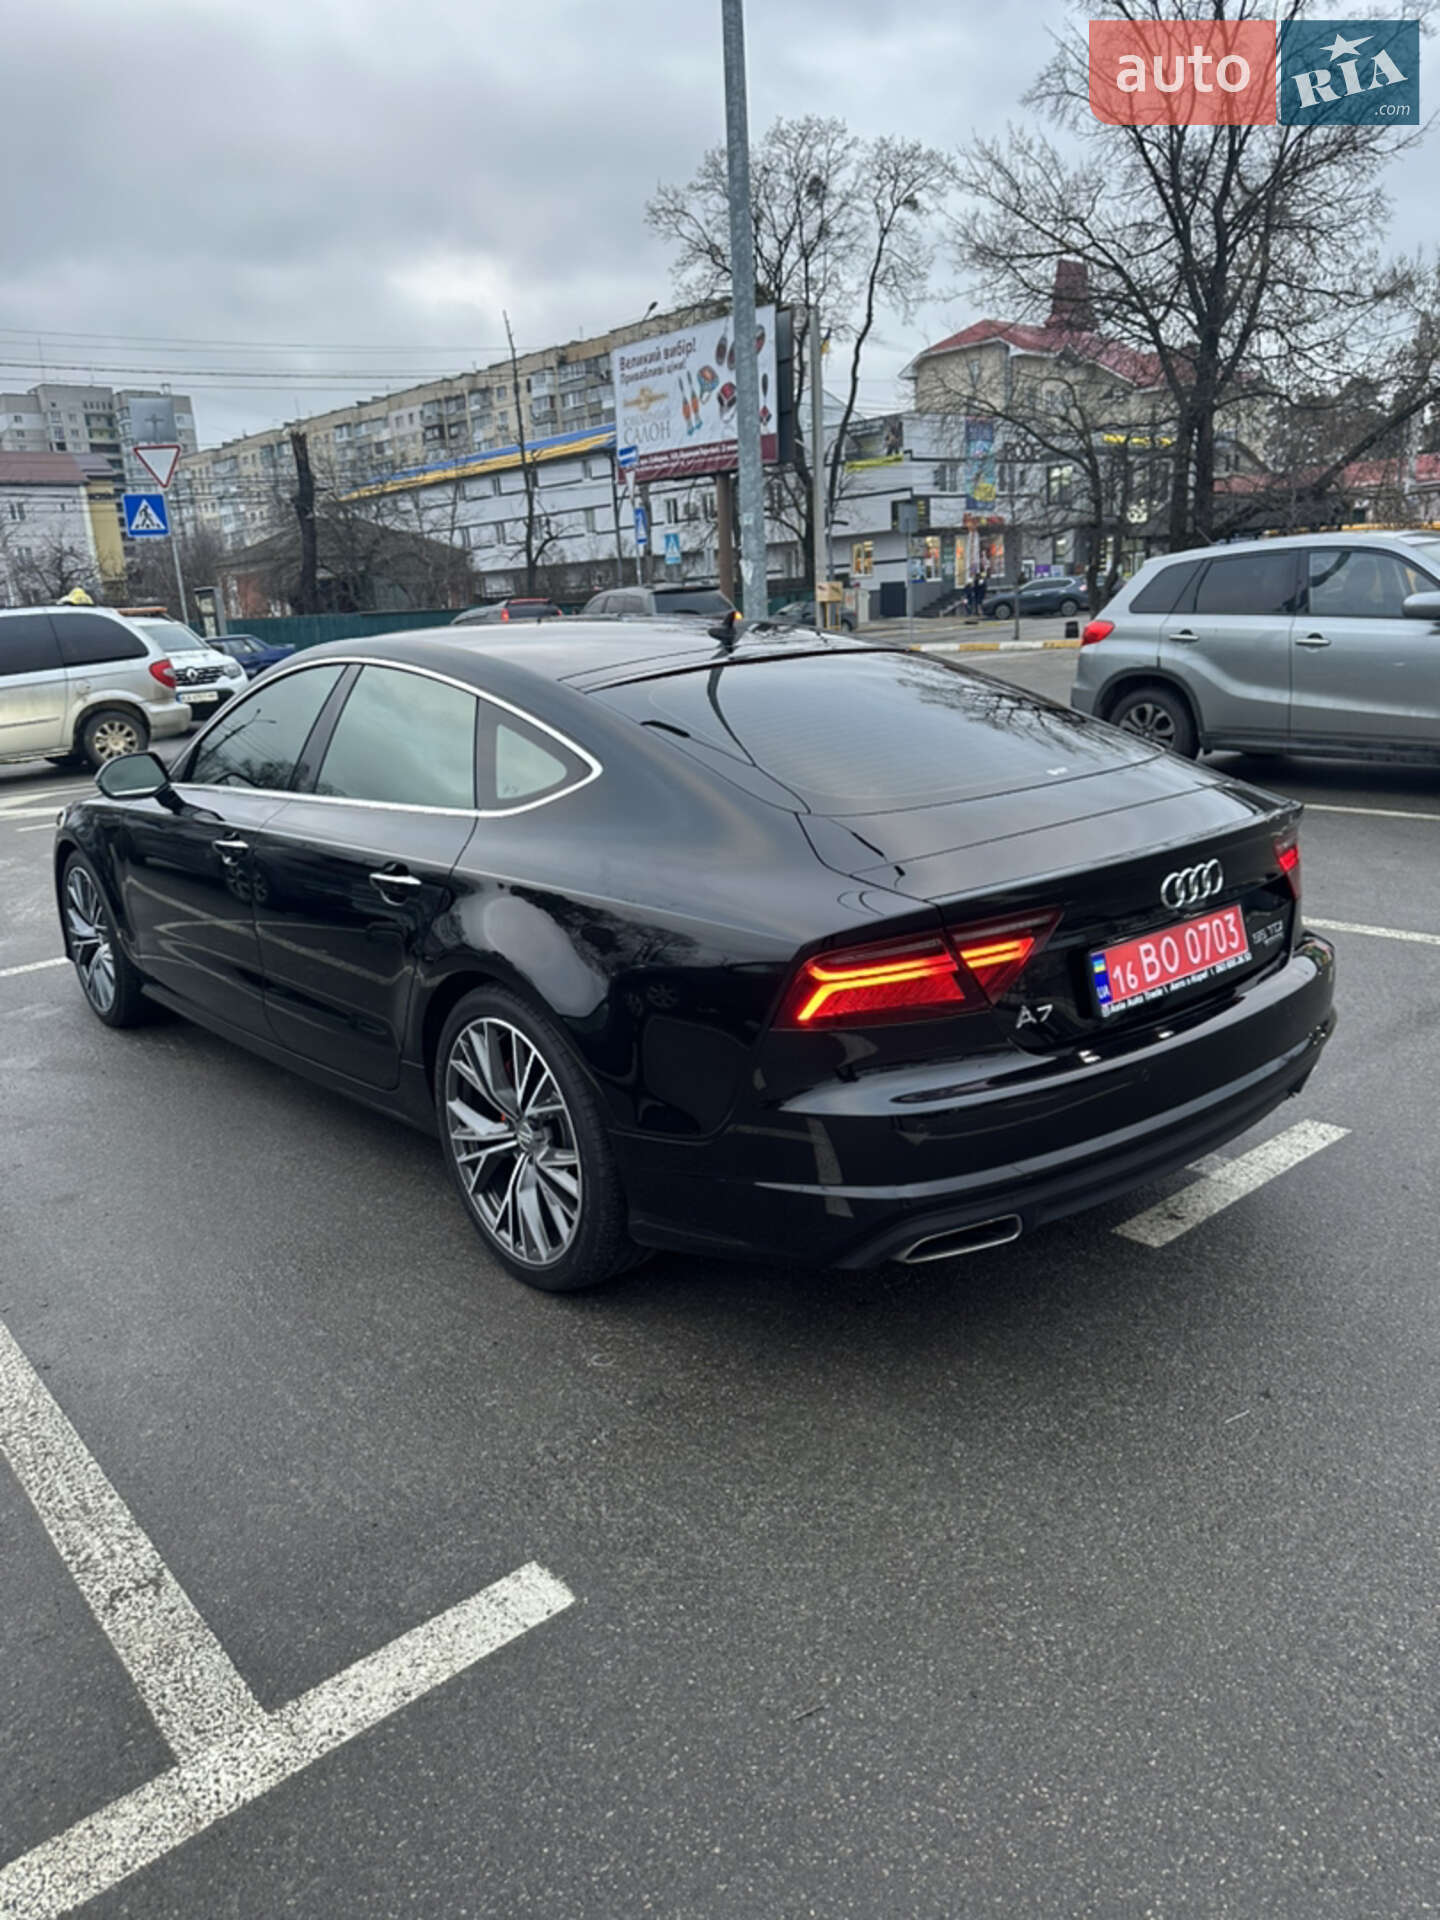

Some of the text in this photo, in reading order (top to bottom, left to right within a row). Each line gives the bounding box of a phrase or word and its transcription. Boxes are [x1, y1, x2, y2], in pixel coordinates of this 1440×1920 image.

[1112, 961, 1139, 994] 16
[1184, 911, 1240, 965] 0703
[1096, 984, 1111, 1000] UA
[1016, 1004, 1054, 1029] A7
